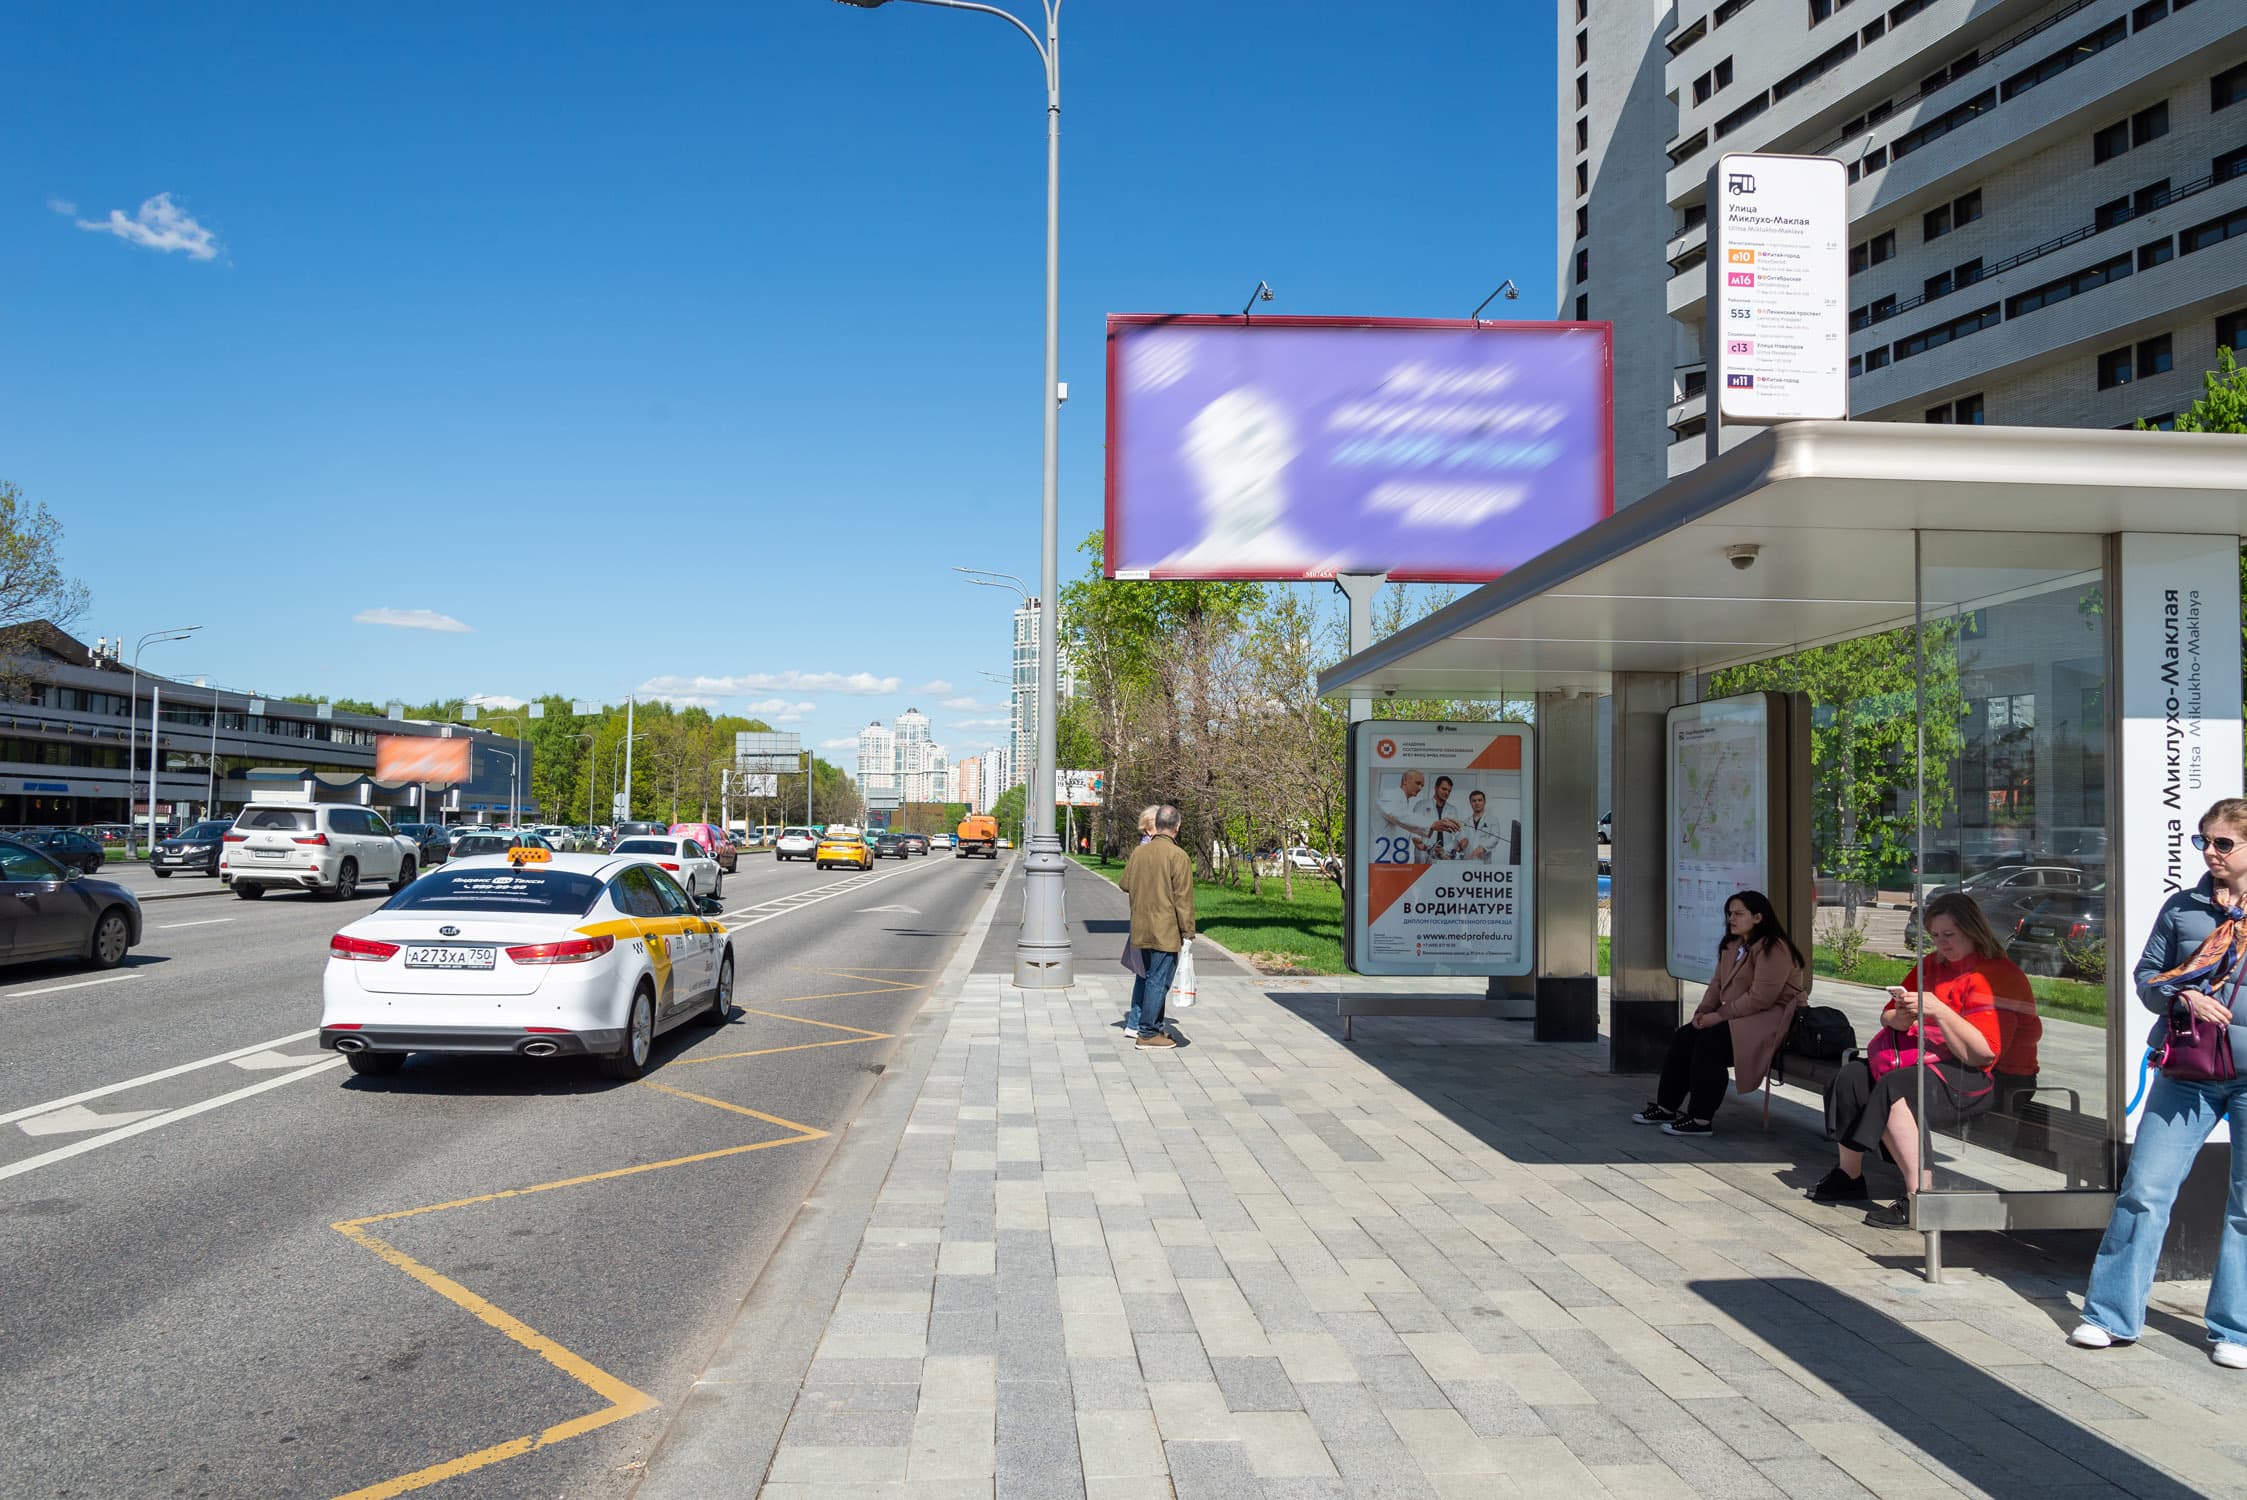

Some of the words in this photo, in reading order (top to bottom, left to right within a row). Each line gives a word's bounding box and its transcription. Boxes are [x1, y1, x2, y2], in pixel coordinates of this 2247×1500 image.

[1728, 203, 1757, 213] Улица
[1728, 214, 1810, 226] Миклухо-Маклая
[1730, 309, 1751, 319] 553
[2186, 590, 2202, 737] Miklukho-Maklaya
[2161, 589, 2184, 810] Миклухо-Маклая
[2189, 746, 2202, 789] Ulitsa
[1374, 836, 1410, 865] 28
[2163, 819, 2184, 893] Улица
[1462, 871, 1513, 883] ОЧНОЕ
[1435, 886, 1513, 899] ОБУЧЕНИЕ
[1403, 902, 1411, 914] В
[1415, 902, 1513, 916] ОРДИНАТУРЕ
[441, 927, 457, 936] KIA
[1423, 931, 1513, 942] www.medprofedu.ru
[470, 950, 491, 960] 750
